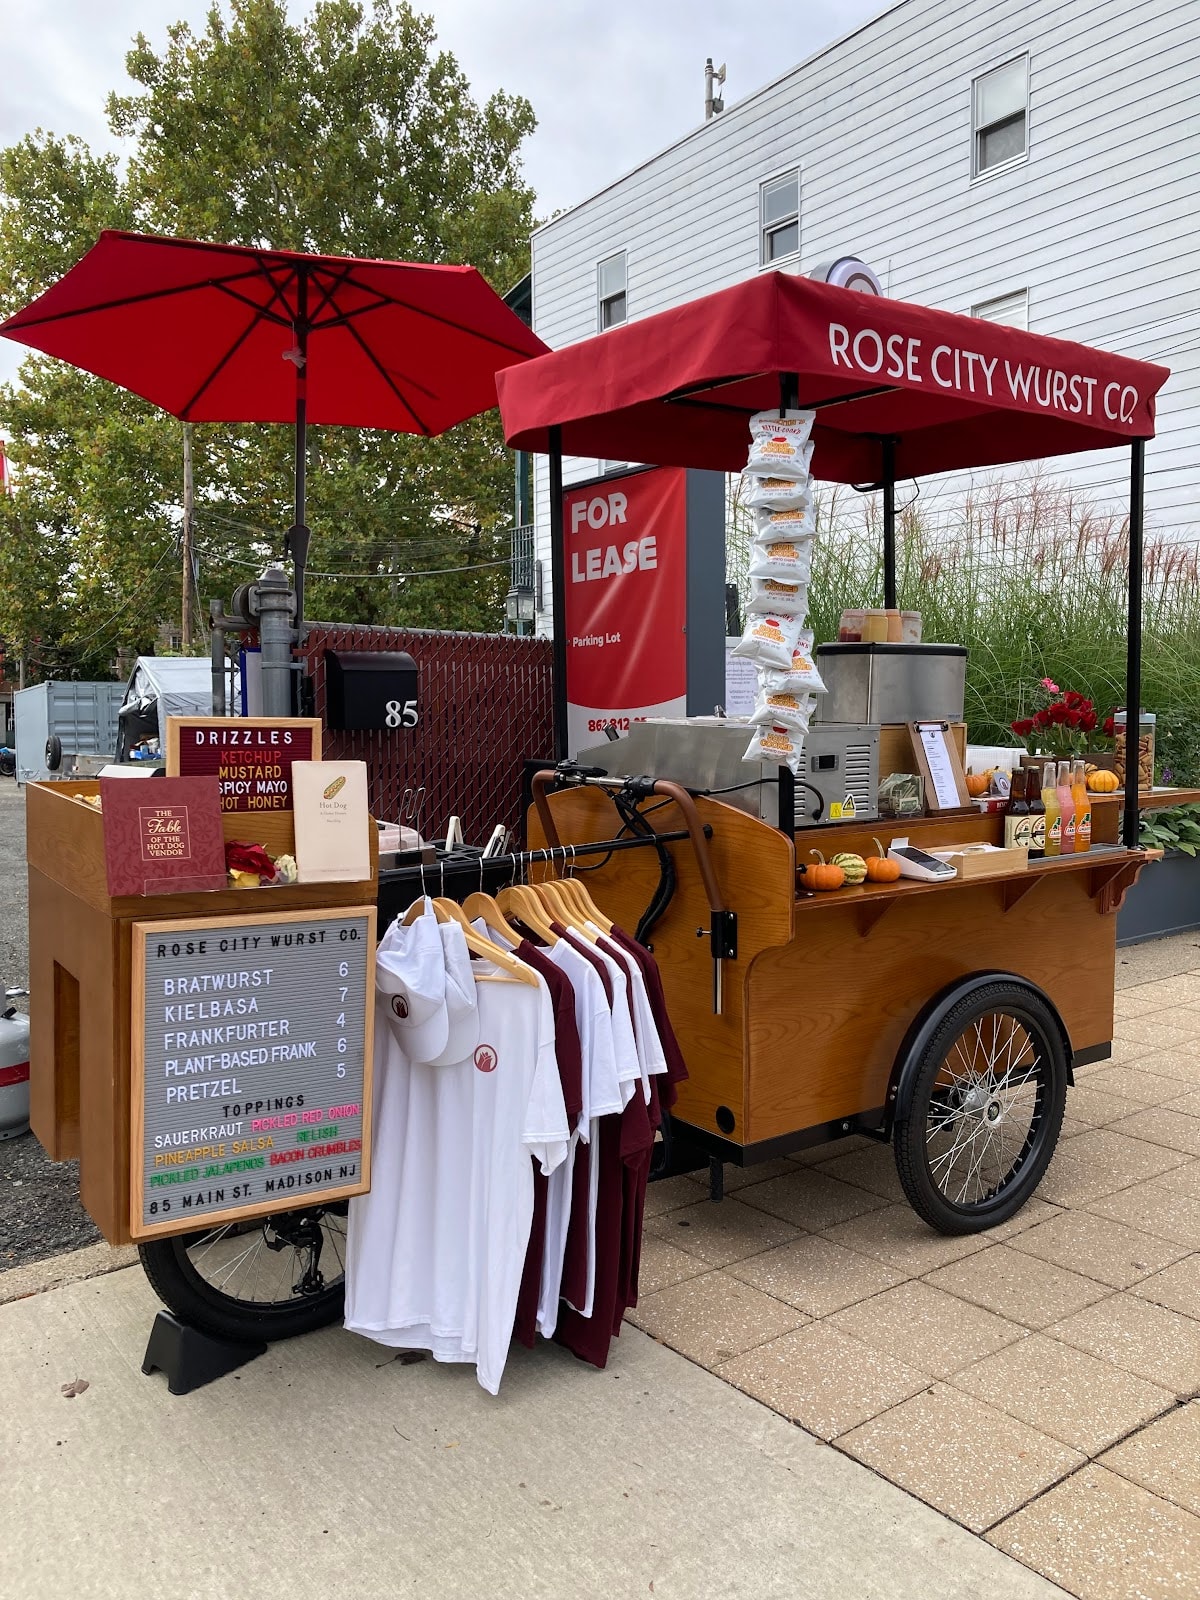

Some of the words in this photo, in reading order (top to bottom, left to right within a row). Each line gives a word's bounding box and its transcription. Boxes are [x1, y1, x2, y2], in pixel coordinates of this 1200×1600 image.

[828, 322, 923, 383] ROSE
[930, 345, 999, 397] CITY
[1004, 359, 1098, 416] WURST
[1104, 381, 1139, 425] CO.
[571, 491, 628, 534] FOR
[571, 535, 658, 583] LEASE
[572, 633, 604, 648] Parking
[605, 632, 621, 645] Lot
[385, 700, 419, 728] 85
[609, 717, 630, 731] 812
[195, 731, 292, 745] DRIZZLES
[219, 765, 282, 779] MUSTARD
[221, 750, 282, 764] KETCHUP
[219, 781, 252, 795] SPICY
[256, 780, 288, 794] MAYO
[247, 795, 287, 809] HONEY
[333, 802, 347, 810] Dog
[147, 818, 182, 834] Fable
[149, 849, 184, 857] VENDOR
[157, 941, 207, 958] ROSE
[219, 937, 261, 953] CITY
[271, 930, 326, 947] WURST
[339, 928, 361, 941] CO.
[164, 969, 274, 996] BRATWURST
[338, 962, 349, 977] 6
[165, 997, 259, 1023] KIELBASA
[338, 987, 348, 1002] 7
[164, 1019, 290, 1050] FRANKFURTER
[336, 1012, 346, 1028] 4
[165, 1047, 268, 1077] PLANT-BASED
[271, 1041, 317, 1063] FRANK
[337, 1038, 347, 1053] 6
[166, 1078, 242, 1104] PRETZEL
[336, 1063, 346, 1078] 5
[223, 1094, 305, 1118] TOPPINGS
[154, 1122, 243, 1148] SAUERKRAUT
[252, 1113, 298, 1132] PICKLED
[302, 1109, 323, 1124] RED
[328, 1104, 360, 1121] ONION
[155, 1143, 225, 1168] PINEAPPLE
[232, 1136, 274, 1154] SALSA
[297, 1125, 340, 1143] RELISH
[150, 1167, 199, 1188] PICKLED
[270, 1148, 305, 1167] BACON
[308, 1138, 362, 1160] CRUMBLES
[149, 1201, 171, 1215] 85
[182, 1189, 225, 1209] MAIN
[232, 1183, 252, 1199] ST.
[265, 1169, 333, 1192] MADISON
[339, 1164, 356, 1178] NJ
